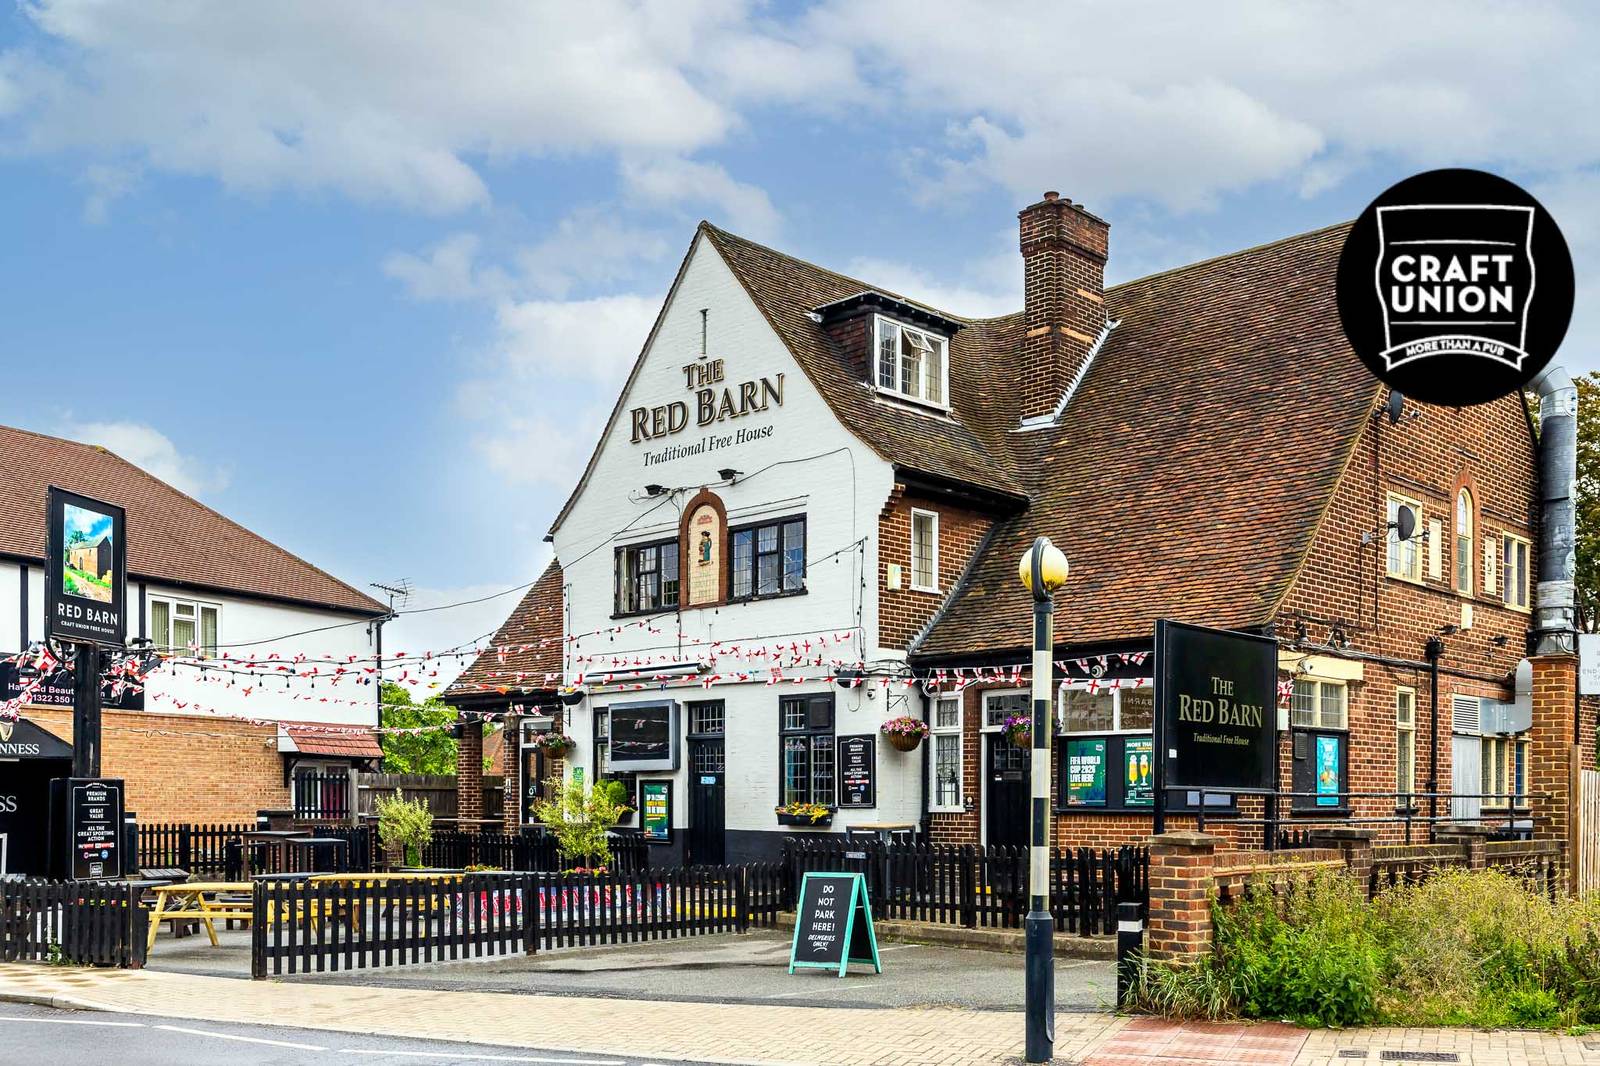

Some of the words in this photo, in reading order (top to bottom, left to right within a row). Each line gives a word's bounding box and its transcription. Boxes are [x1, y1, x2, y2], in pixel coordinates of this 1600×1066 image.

[682, 358, 724, 389] THE
[629, 400, 689, 444] RED
[695, 372, 785, 427] BARN
[643, 438, 706, 467] Traditional
[708, 435, 732, 452] Free
[735, 425, 774, 445] House
[58, 602, 82, 618] RED
[87, 608, 118, 626] BARN
[48, 686, 74, 695] Beaut
[1211, 676, 1234, 696] THE
[32, 694, 53, 702] 1322
[54, 695, 70, 703] 350
[1178, 694, 1214, 723] RED
[1218, 698, 1263, 728] BARN
[1193, 732, 1222, 743] Traditional
[1223, 734, 1234, 744] Free
[1234, 735, 1249, 746] House
[1081, 755, 1100, 764] WORLD
[1081, 774, 1094, 782] HERE
[822, 885, 834, 894] DO
[817, 897, 835, 907] NOT
[814, 910, 835, 919] PARK
[812, 922, 835, 931] HERE!
[808, 934, 835, 942] DELIVERIES
